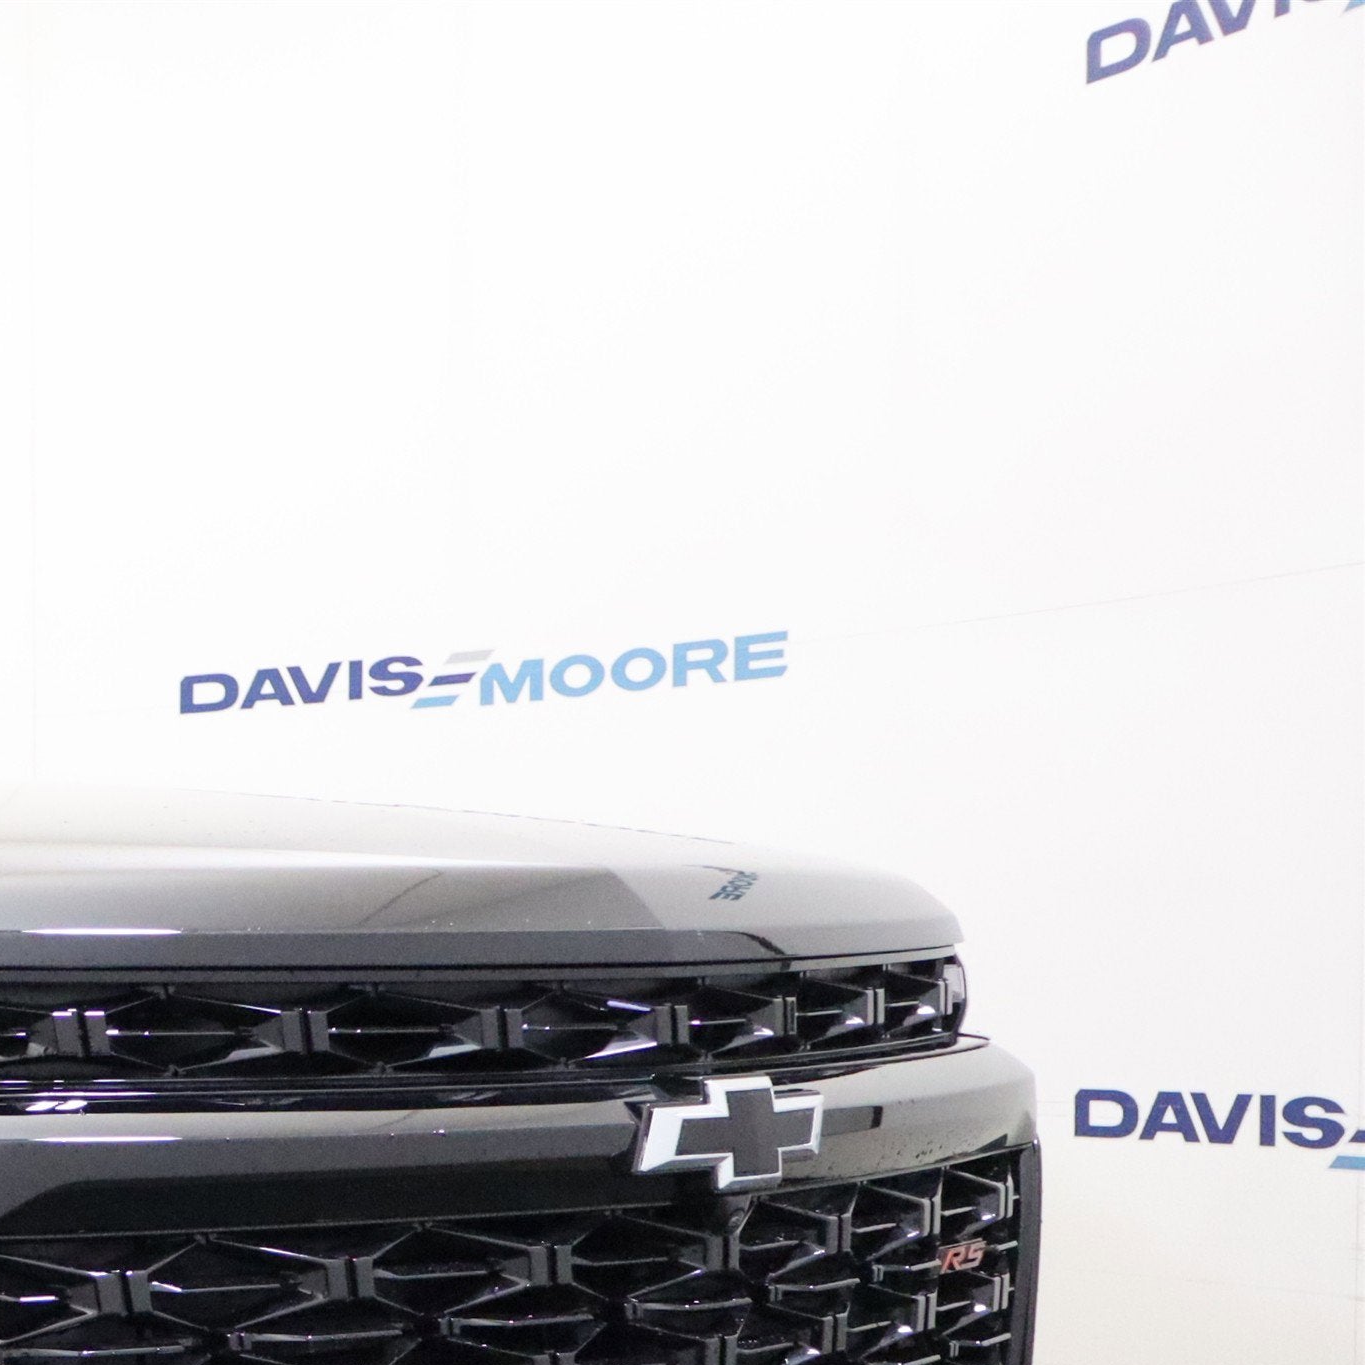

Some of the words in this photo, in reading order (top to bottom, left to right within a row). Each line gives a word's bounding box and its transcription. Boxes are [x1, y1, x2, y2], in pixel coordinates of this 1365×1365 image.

[1086, 0, 1321, 84] DAV
[178, 655, 424, 716] DAVIS
[479, 630, 789, 707] MOORE
[1073, 1088, 1346, 1150] DAVIS
[940, 1240, 987, 1275] RS
